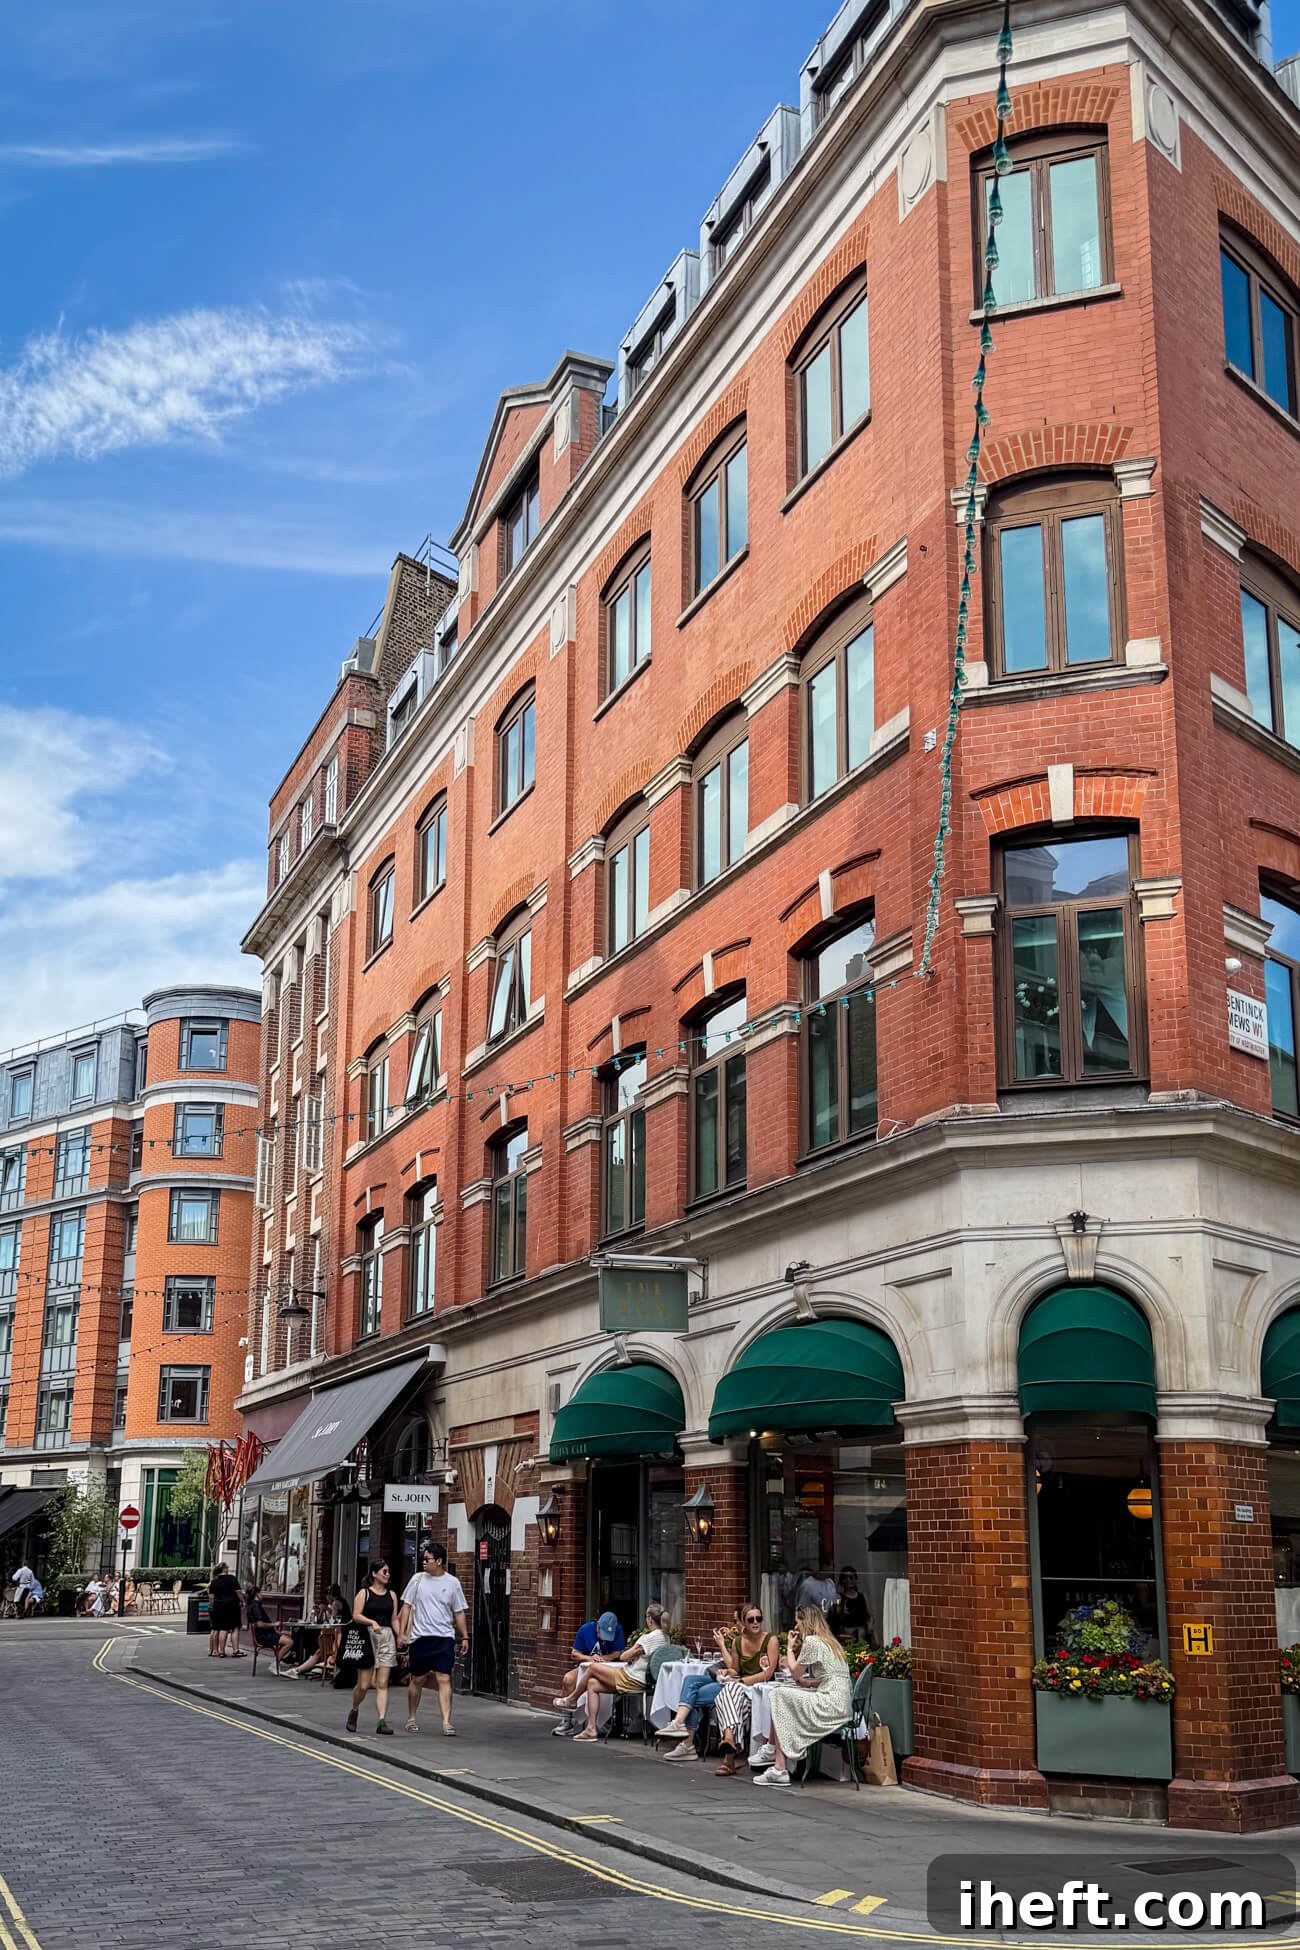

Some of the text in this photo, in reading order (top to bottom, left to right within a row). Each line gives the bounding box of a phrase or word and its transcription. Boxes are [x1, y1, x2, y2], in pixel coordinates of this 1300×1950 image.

[1252, 1022, 1263, 1039] W1
[392, 1493, 432, 1503] St. JOHN
[1187, 1627, 1209, 1652] H
